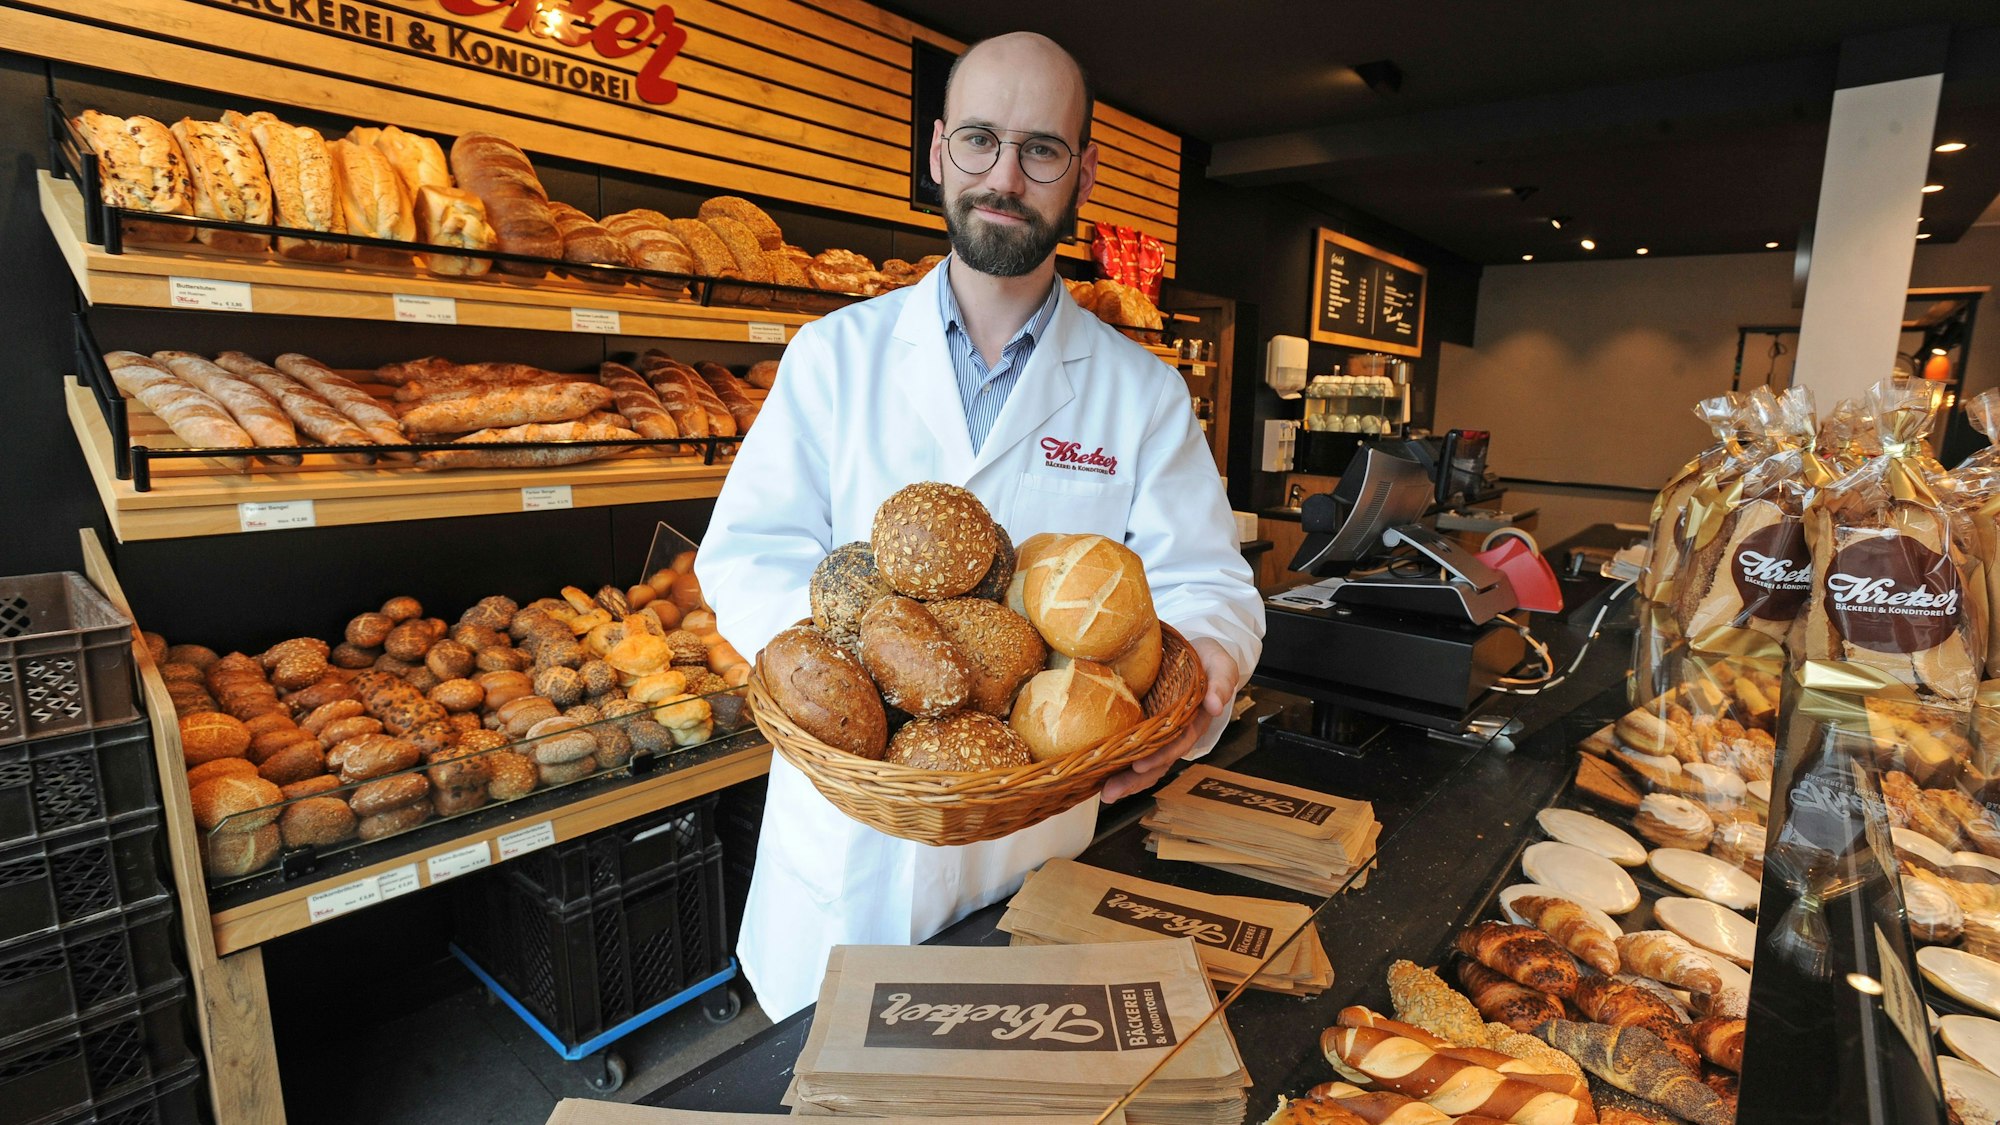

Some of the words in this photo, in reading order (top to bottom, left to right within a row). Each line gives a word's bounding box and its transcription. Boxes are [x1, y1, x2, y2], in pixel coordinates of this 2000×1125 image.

[408, 21, 436, 52] &
[446, 25, 629, 100] KONDITOREI
[176, 283, 216, 291] Butterstuten
[1041, 437, 1117, 475] Kretzer
[1744, 576, 1775, 590] BÄCKEREI
[1827, 573, 1958, 616] Kretzer
[1835, 602, 1876, 613] BÄCKEREI
[1888, 606, 1944, 617] KONDITOREI
[1201, 781, 1295, 814] Kretzer
[1106, 893, 1228, 944] Kretzer
[1236, 924, 1258, 954] BÄCKEREI
[880, 993, 1104, 1044] Kretzer
[1125, 988, 1148, 1047] BÄCKEREI
[1146, 988, 1166, 1033] KONDITOREI
[1156, 1034, 1168, 1044] &
